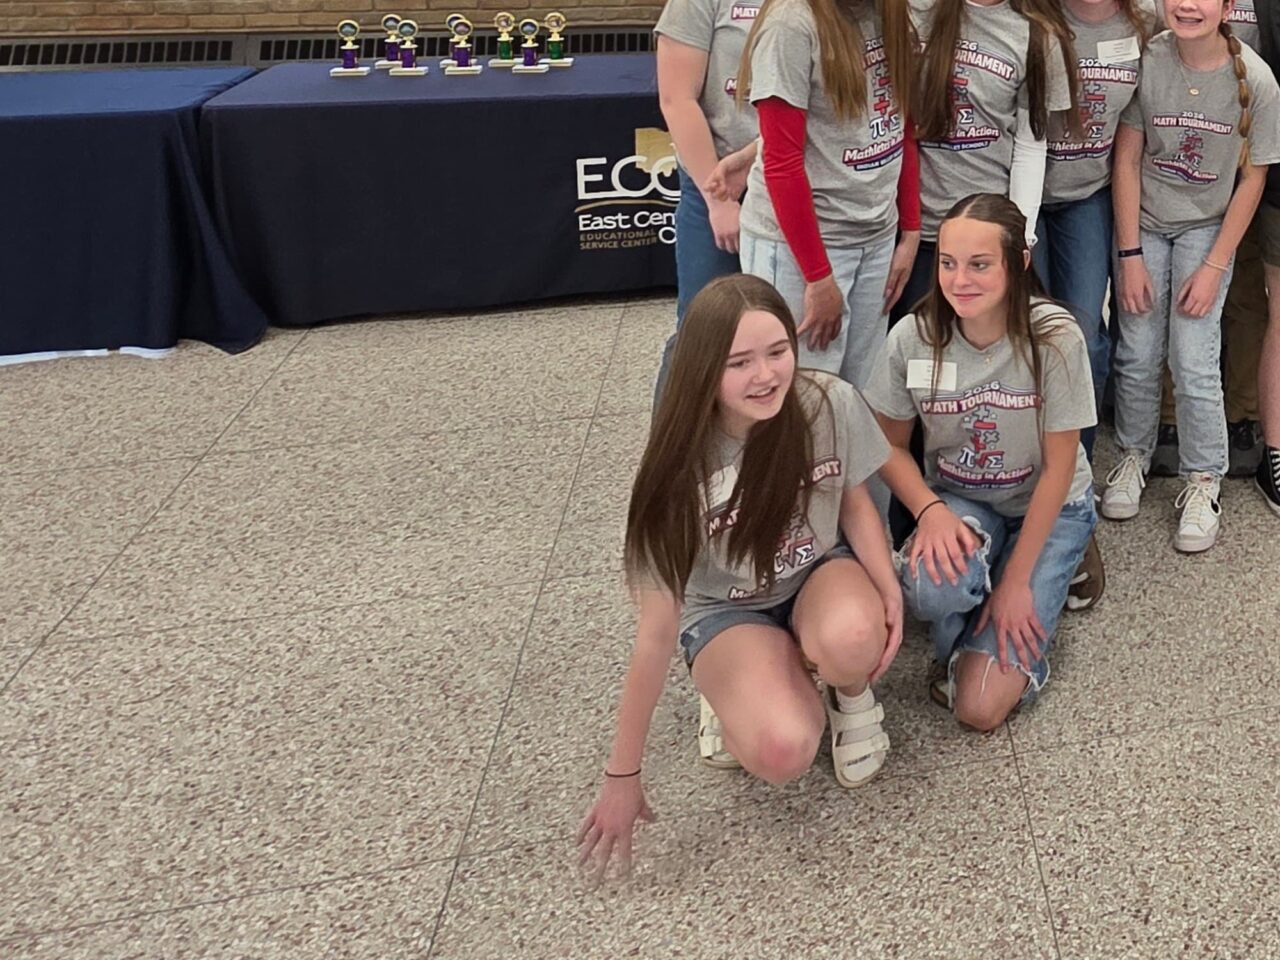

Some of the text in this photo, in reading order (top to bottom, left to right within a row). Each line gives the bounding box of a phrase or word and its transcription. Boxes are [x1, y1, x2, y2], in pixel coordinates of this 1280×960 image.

[967, 126, 999, 138] Action
[1153, 116, 1232, 134] MATH TOURNAMENT
[579, 212, 631, 231] East
[580, 228, 657, 241] EDUCATIONAL
[580, 236, 658, 250] SERVICE CENTER
[964, 381, 1000, 398] 2026
[996, 466, 1033, 480] Action
